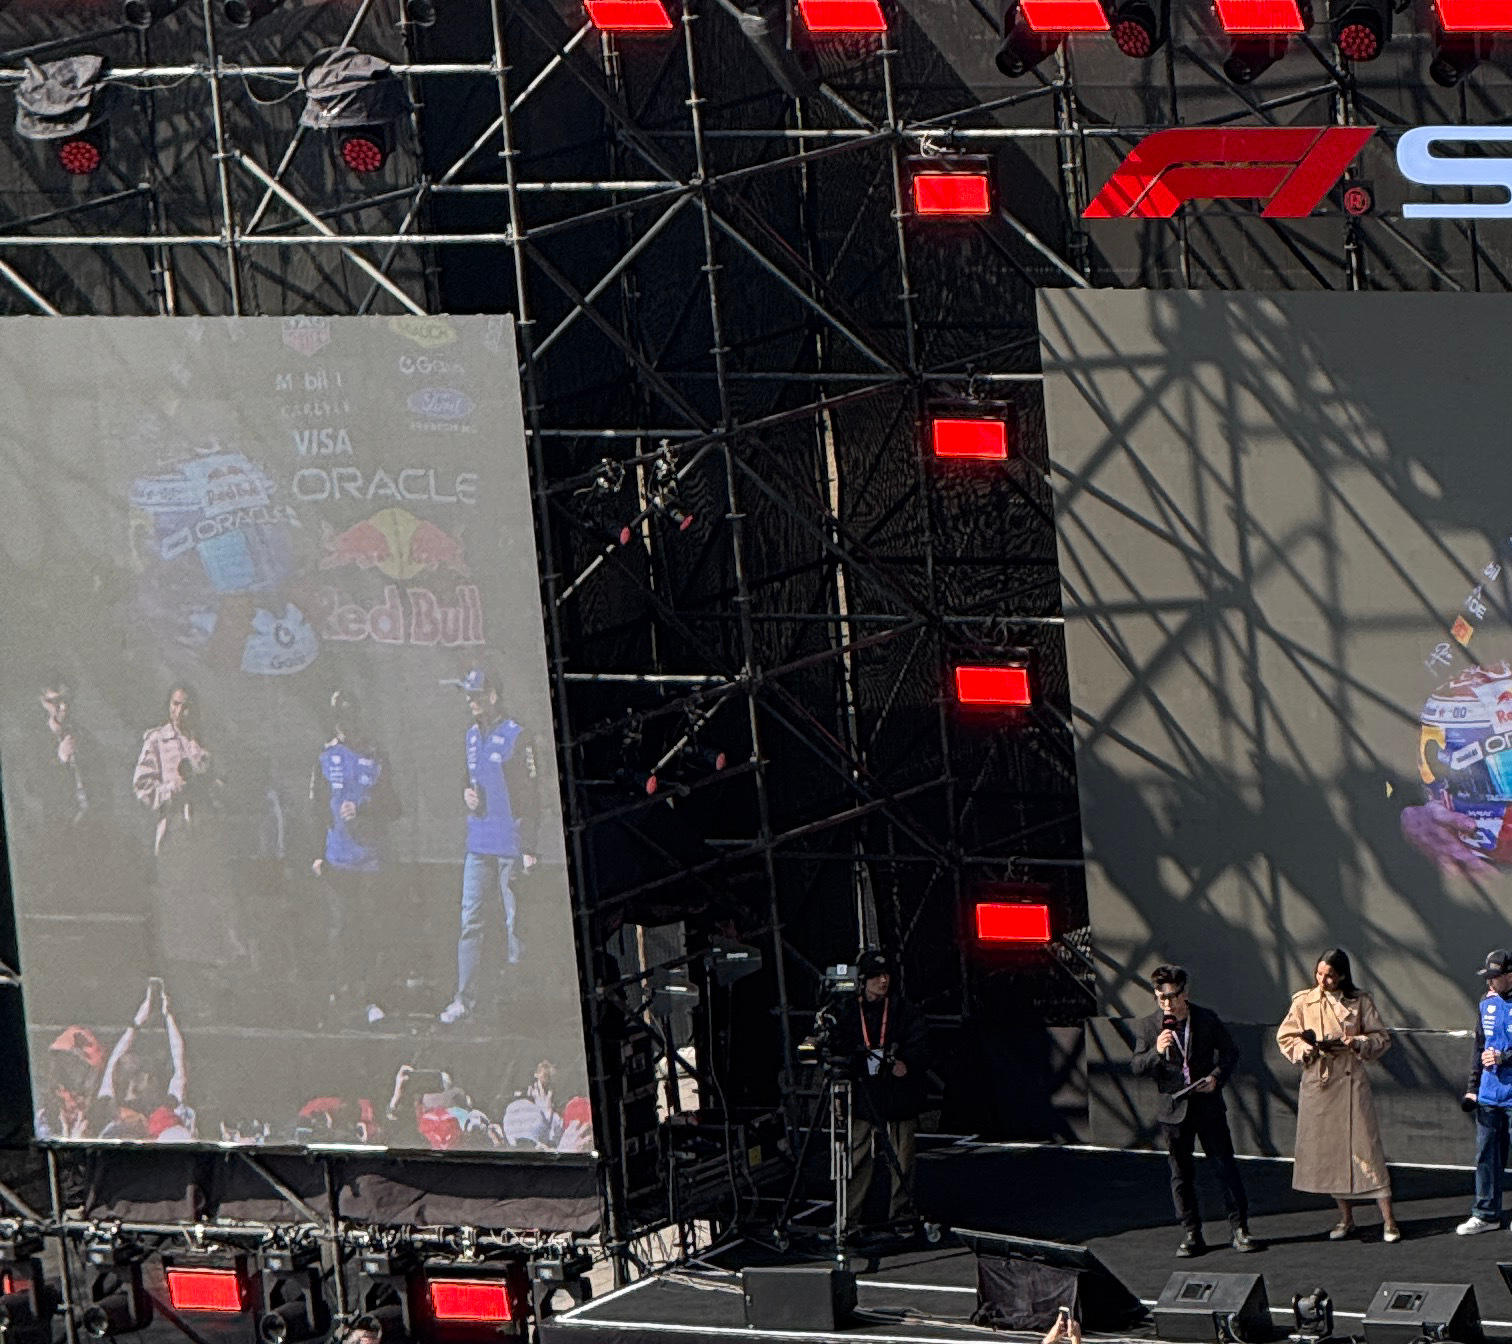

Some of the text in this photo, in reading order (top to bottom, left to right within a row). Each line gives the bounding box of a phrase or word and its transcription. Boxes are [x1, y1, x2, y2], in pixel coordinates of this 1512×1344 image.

[291, 428, 353, 457] VISA
[293, 467, 480, 505] ORACLE
[408, 583, 487, 648] Bull
